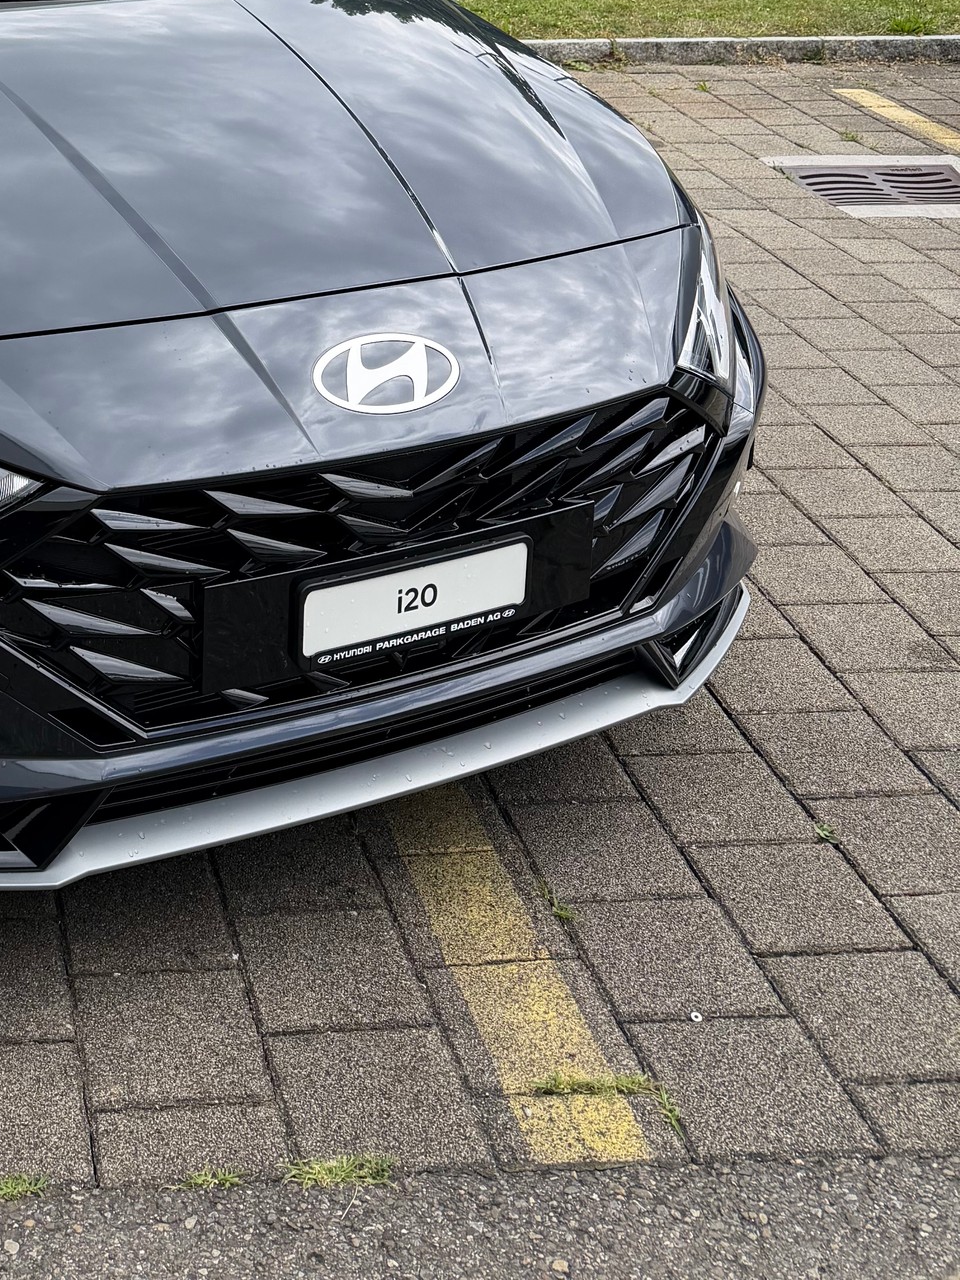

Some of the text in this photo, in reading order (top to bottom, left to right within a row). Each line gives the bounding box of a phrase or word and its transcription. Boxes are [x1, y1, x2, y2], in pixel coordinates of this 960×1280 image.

[396, 583, 438, 614] i20
[333, 612, 501, 661] HYUNDAI PARKGARAGE BADEN AG
